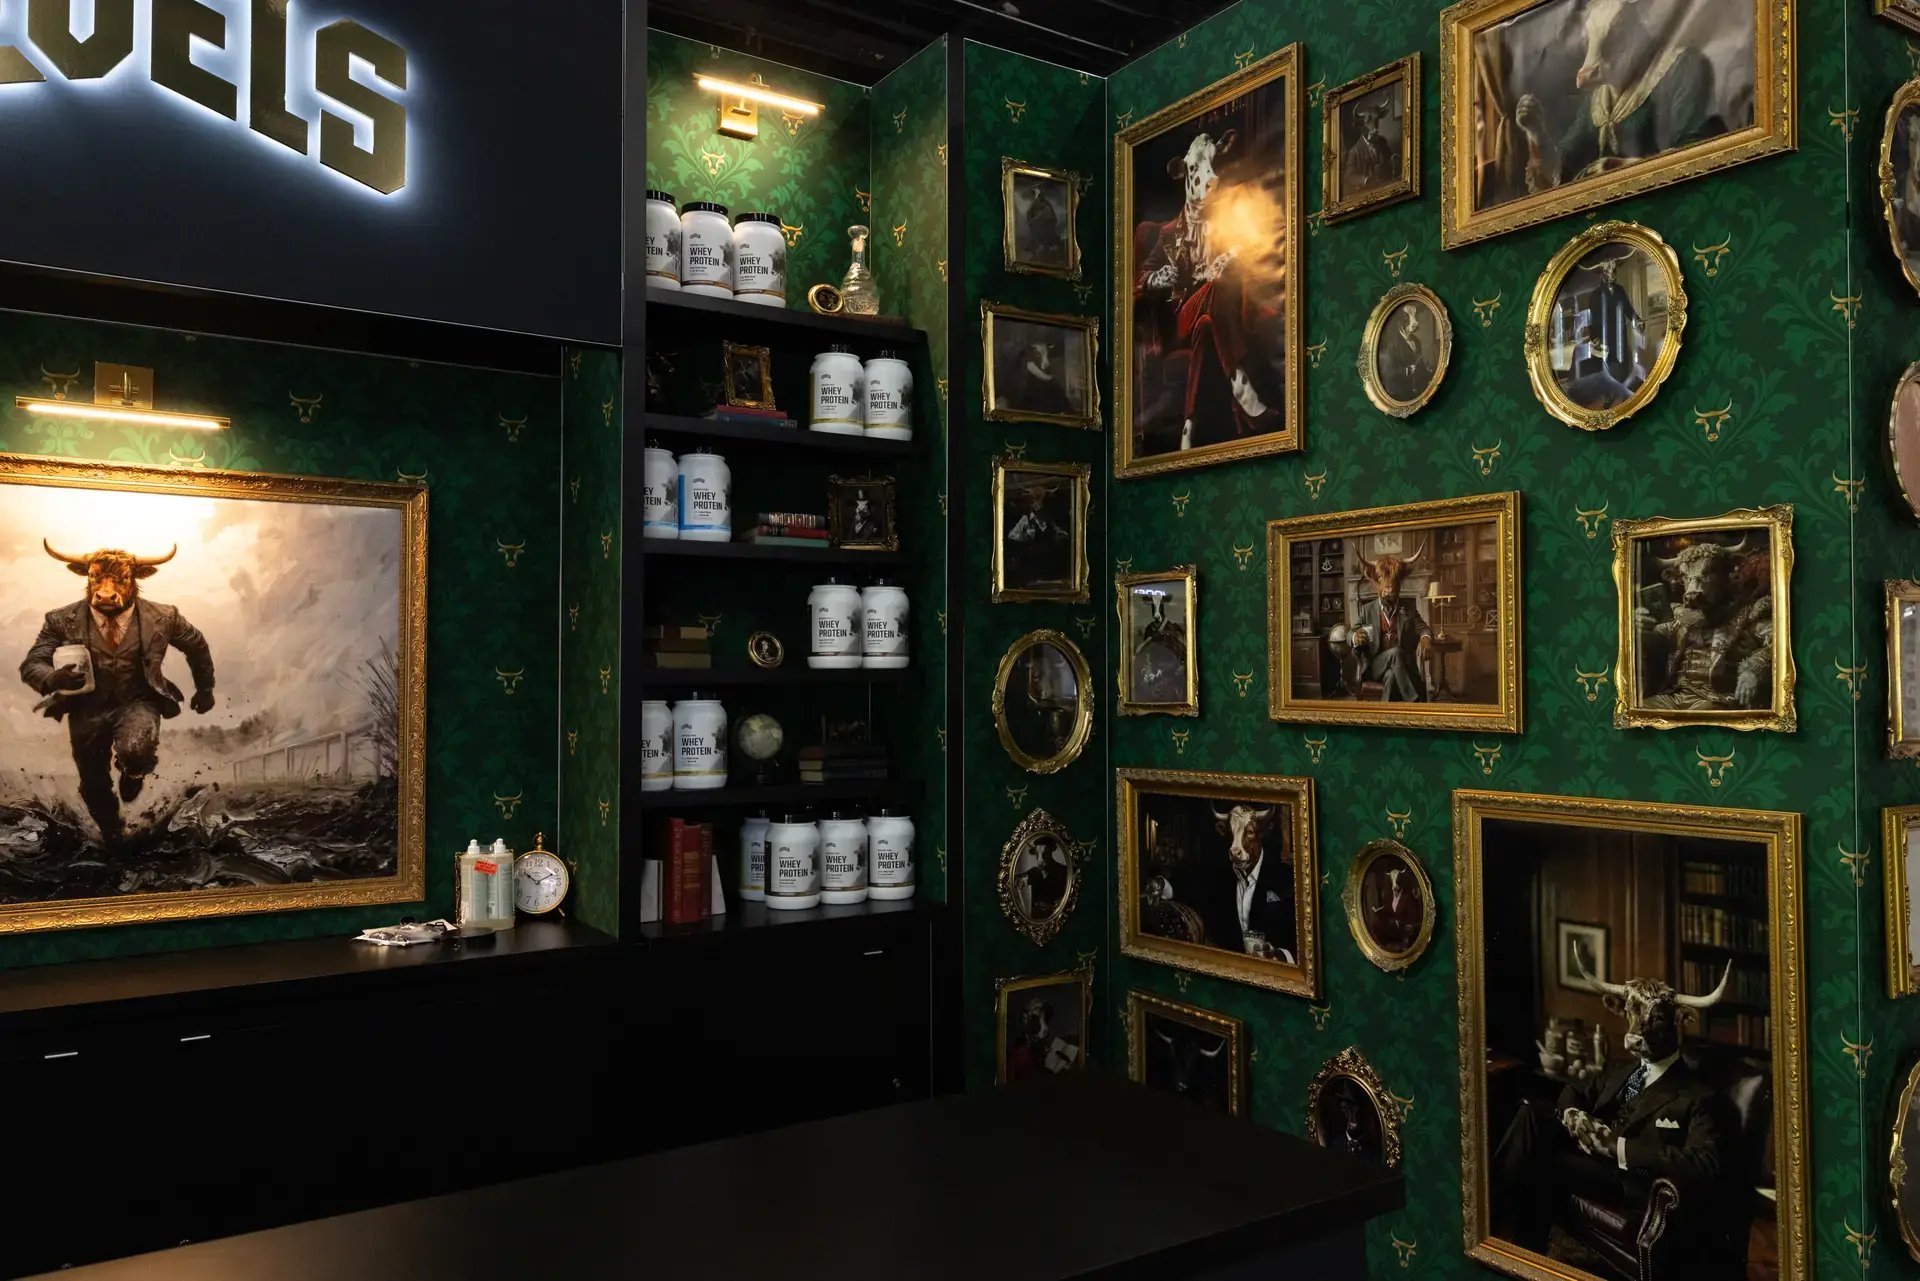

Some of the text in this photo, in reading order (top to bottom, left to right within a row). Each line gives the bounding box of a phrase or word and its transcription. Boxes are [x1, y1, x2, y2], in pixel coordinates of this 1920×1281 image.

[645, 236, 655, 245] EY
[646, 246, 663, 256] TEIN
[690, 247, 712, 256] WHEY
[690, 257, 720, 267] PROTEIN
[740, 257, 761, 265] WHEY
[740, 266, 769, 275] PROTEIN
[821, 387, 842, 395] WHEY
[821, 396, 849, 404] PROTEIN
[870, 392, 891, 401] WHEY
[870, 401, 898, 410] PROTEIN
[644, 487, 654, 495] EY
[694, 492, 716, 500] WHEY
[646, 497, 662, 506] TEIN
[694, 501, 722, 510] PROTEIN
[818, 620, 840, 628] WHEY
[867, 622, 888, 630] WHEY
[818, 629, 847, 638] PROTEIN
[868, 630, 894, 638] PROTEIN
[641, 740, 650, 748] EY
[682, 738, 704, 746] WHEY
[642, 750, 658, 758] TEIN
[682, 747, 712, 756] PROTEIN
[826, 856, 847, 864] WHEY
[878, 852, 899, 860] WHEY
[780, 860, 802, 868] WHEY
[826, 864, 854, 872] PROTEIN
[878, 860, 905, 869] PROTEIN
[780, 869, 808, 878] PROTEIN
